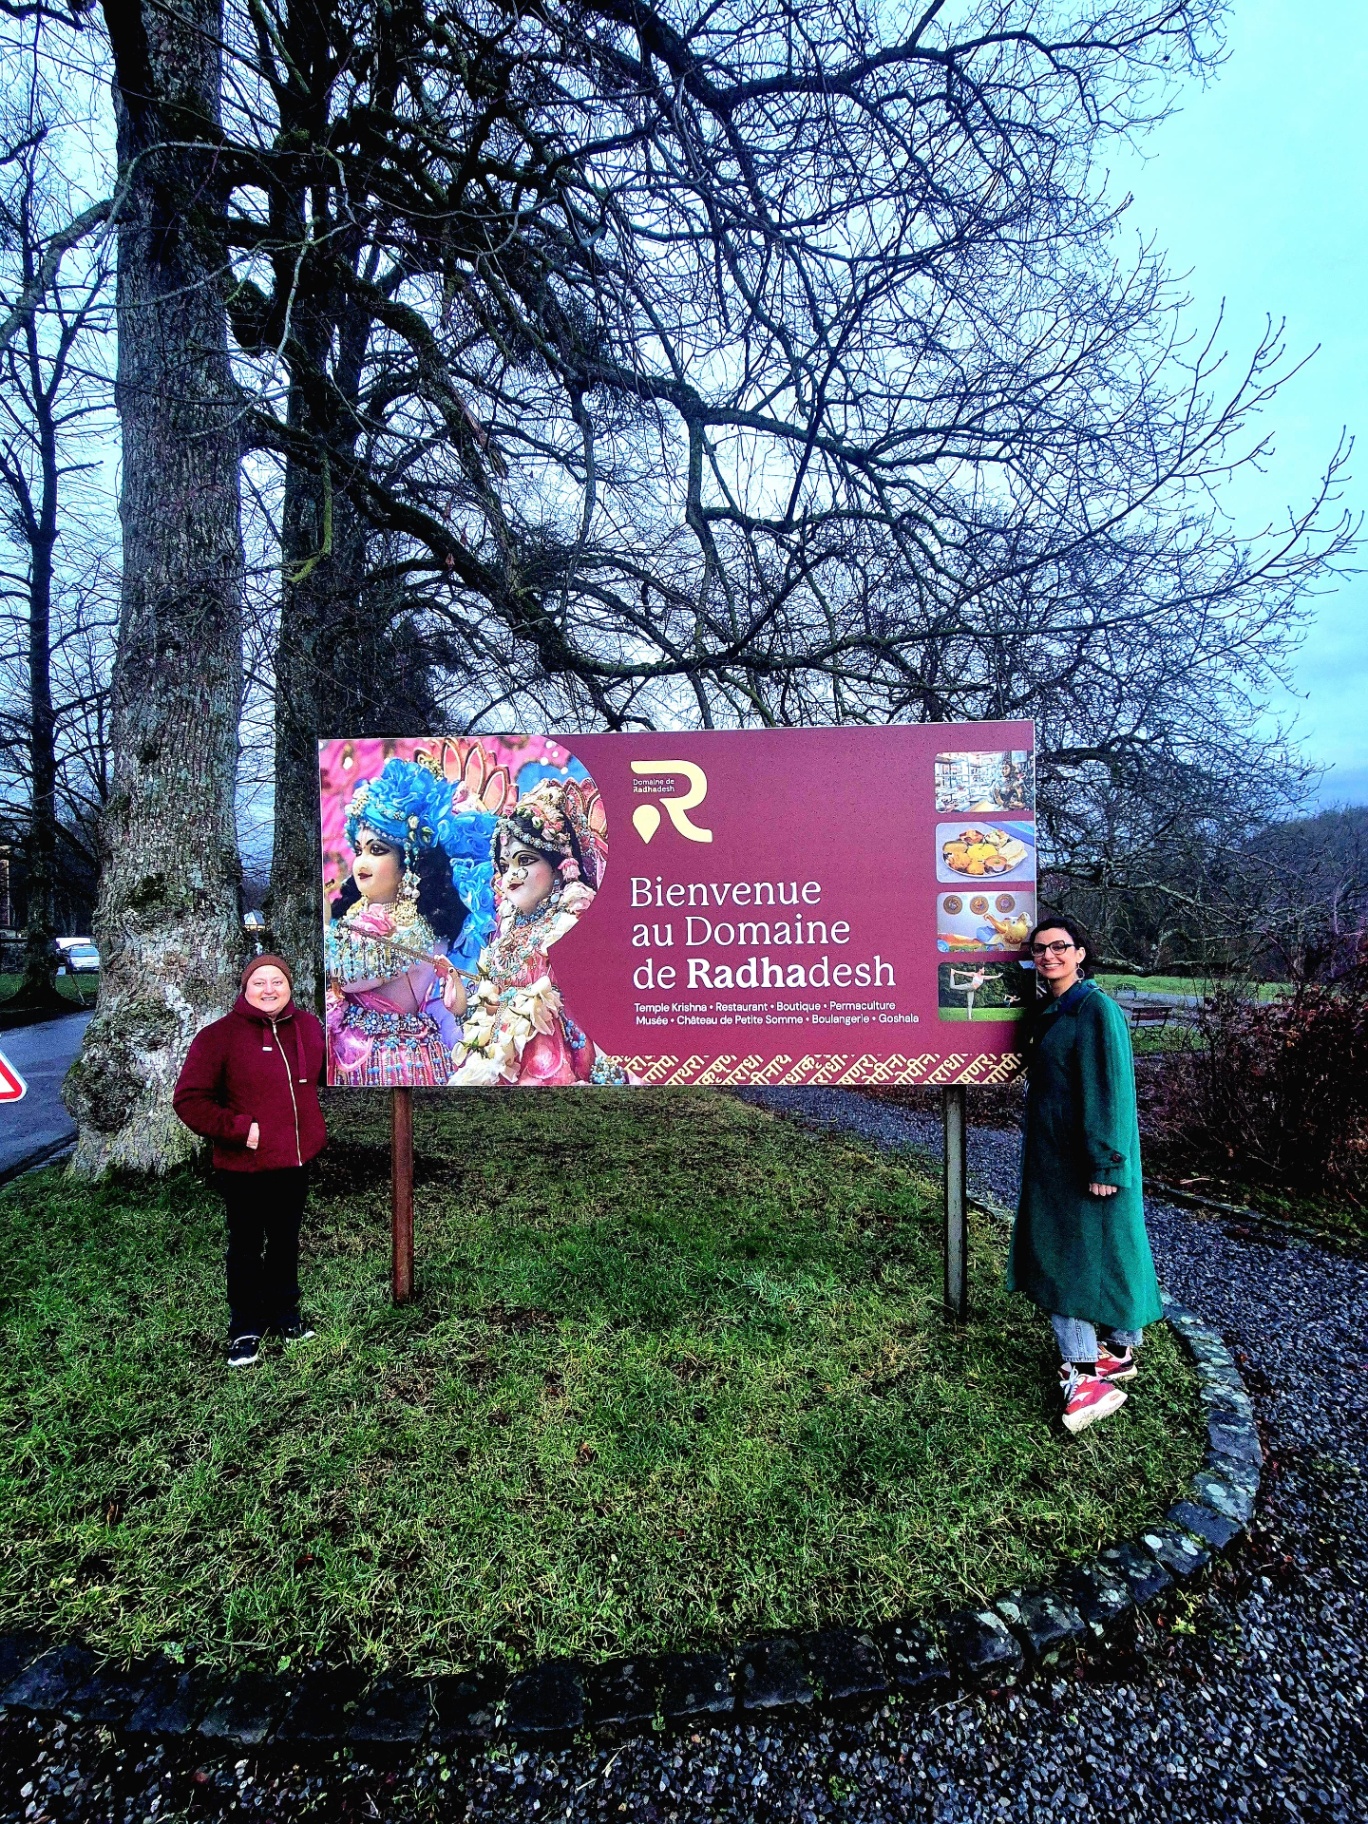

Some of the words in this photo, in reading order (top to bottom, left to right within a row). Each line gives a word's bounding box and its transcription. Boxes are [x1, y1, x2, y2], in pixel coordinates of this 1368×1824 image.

[633, 778, 664, 786] Domaine
[633, 785, 675, 793] Radhadesh
[630, 875, 822, 907] Bienvenue
[631, 923, 675, 947] au
[684, 913, 851, 946] Domaine
[632, 957, 677, 990] de
[686, 954, 897, 989] Radhadesh
[634, 1002, 670, 1014] Temple
[671, 1002, 708, 1012] Krishna
[715, 1001, 768, 1012] Restaurant
[776, 1001, 821, 1013] Boutique
[829, 1000, 896, 1010] Permaculture
[636, 1015, 669, 1025] Musée
[676, 1014, 718, 1025] Château
[719, 1014, 733, 1025] de
[734, 1014, 764, 1025] Petite
[765, 1014, 804, 1025] Somme
[811, 1013, 870, 1026] Boulangerie
[878, 1012, 920, 1024] Goshala
